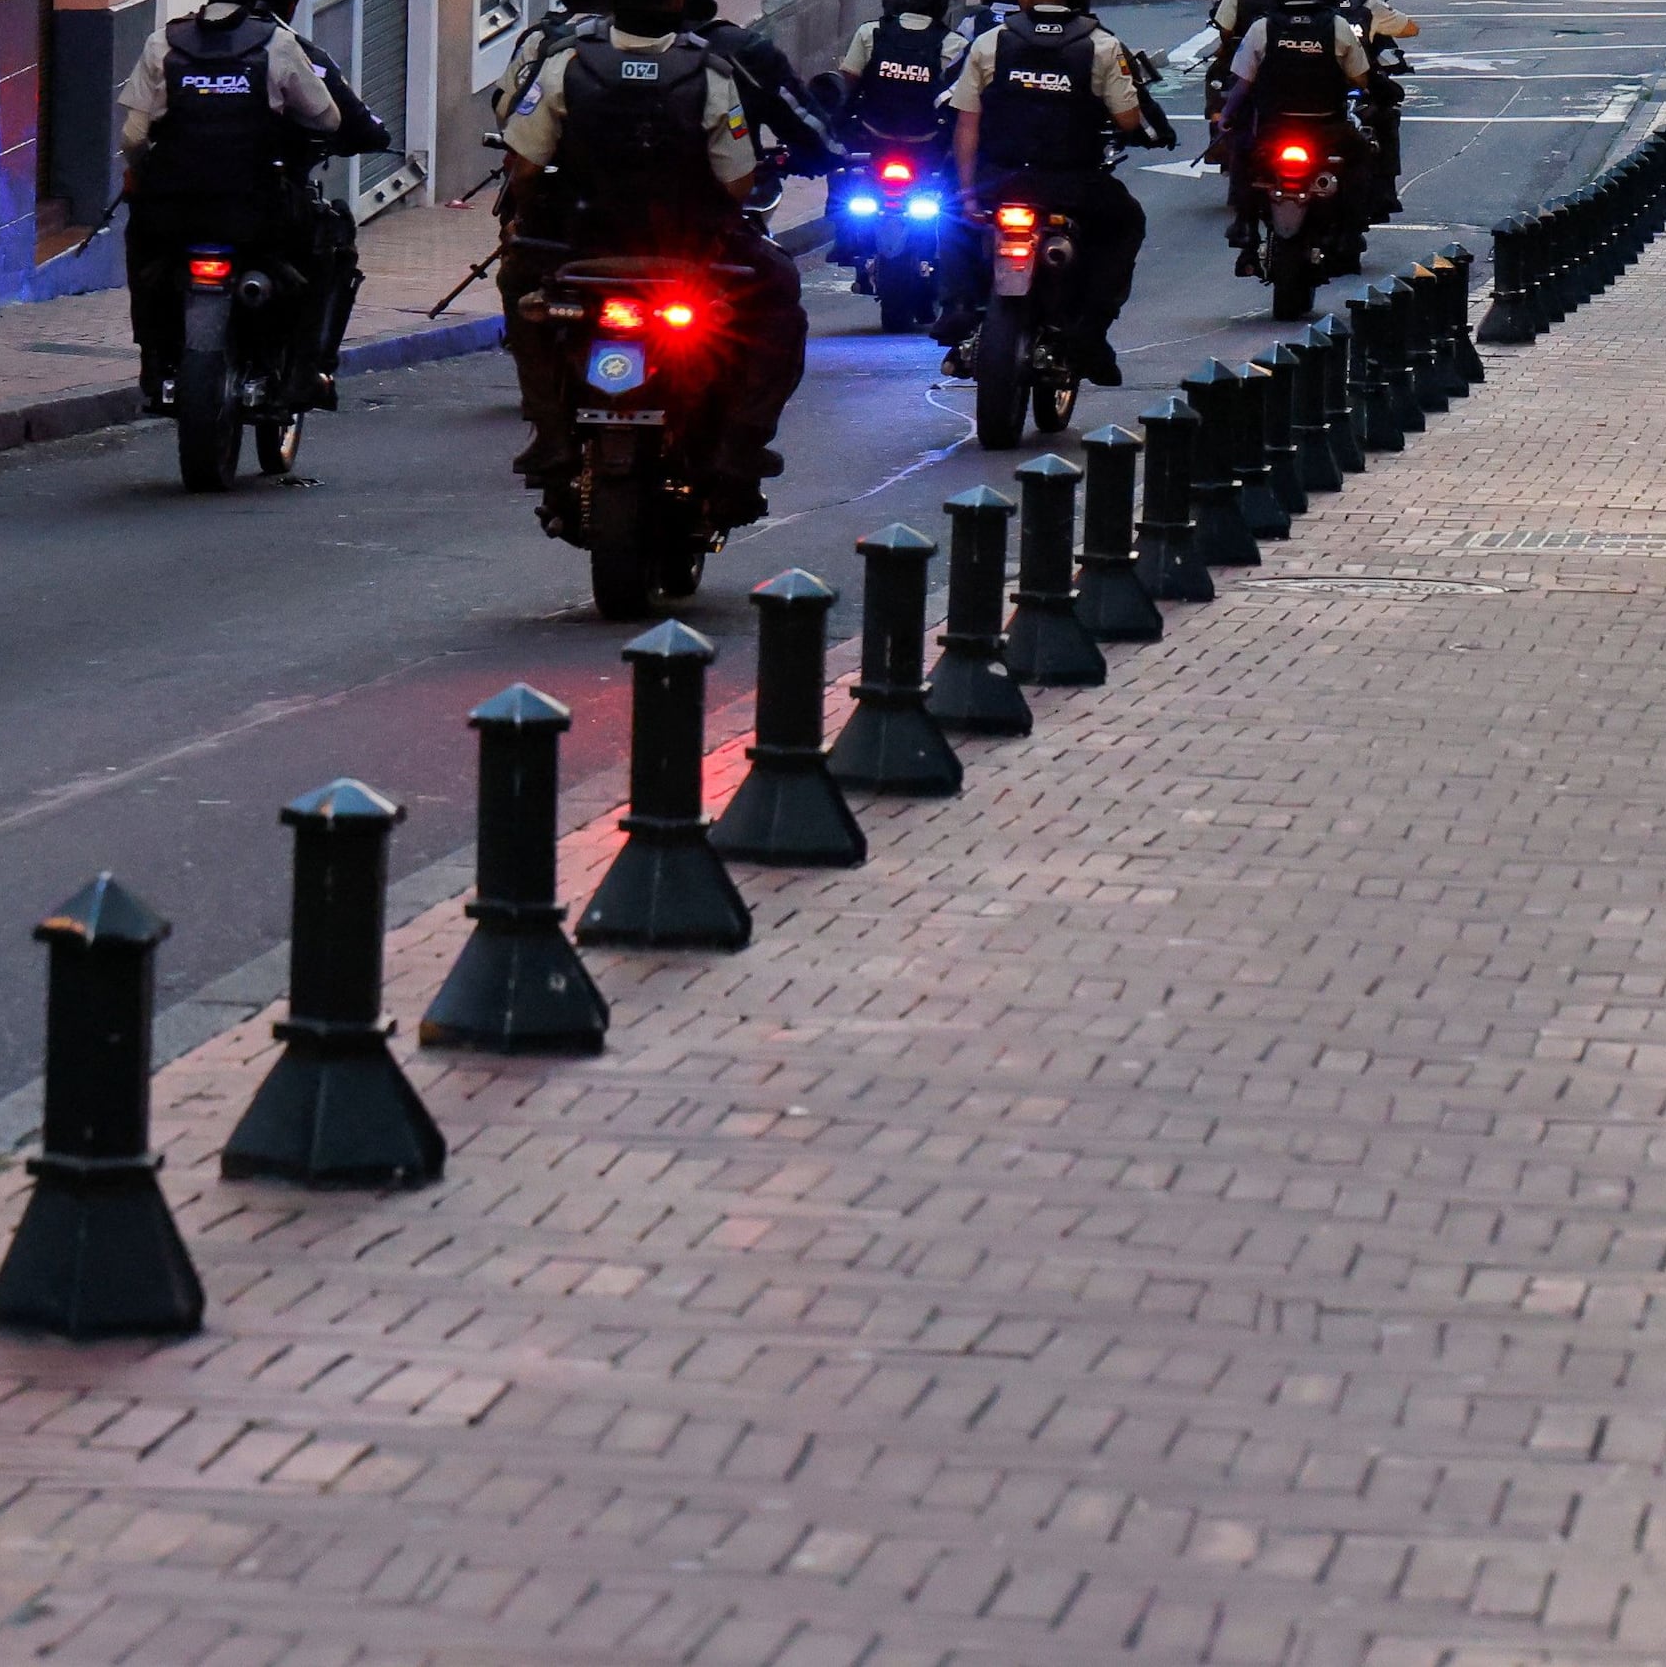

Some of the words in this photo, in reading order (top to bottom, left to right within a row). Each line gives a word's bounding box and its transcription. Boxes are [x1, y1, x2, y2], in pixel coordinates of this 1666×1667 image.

[1278, 39, 1323, 50] POLICIA
[880, 60, 930, 78] POLICIA
[181, 75, 251, 88] POLICIA
[878, 71, 931, 83] ECUADOR
[1009, 70, 1072, 87] POLICIA
